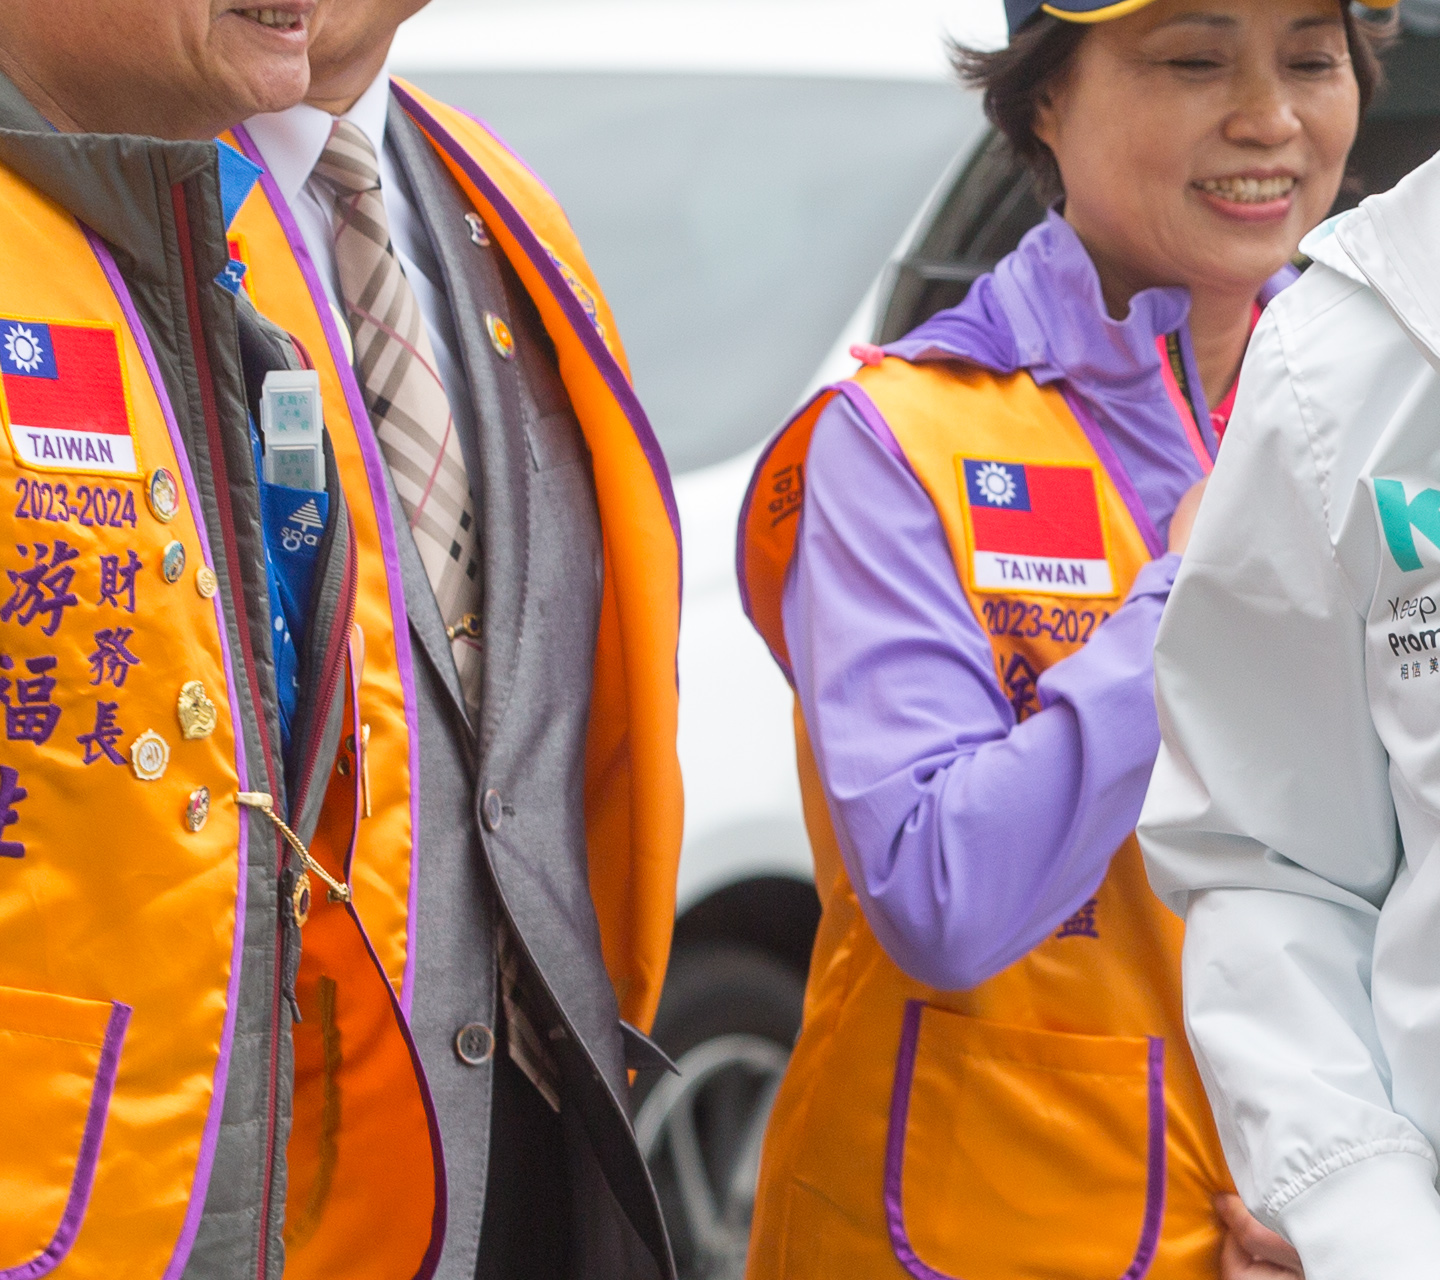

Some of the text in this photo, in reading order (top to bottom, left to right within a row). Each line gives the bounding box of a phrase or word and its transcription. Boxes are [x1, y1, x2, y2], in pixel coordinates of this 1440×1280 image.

[27, 432, 114, 464] TAIWAN
[15, 477, 137, 528] 2023-2024
[995, 558, 1087, 586] TAIWAN
[1388, 595, 1437, 624] Keep
[76, 549, 143, 766] 財務長
